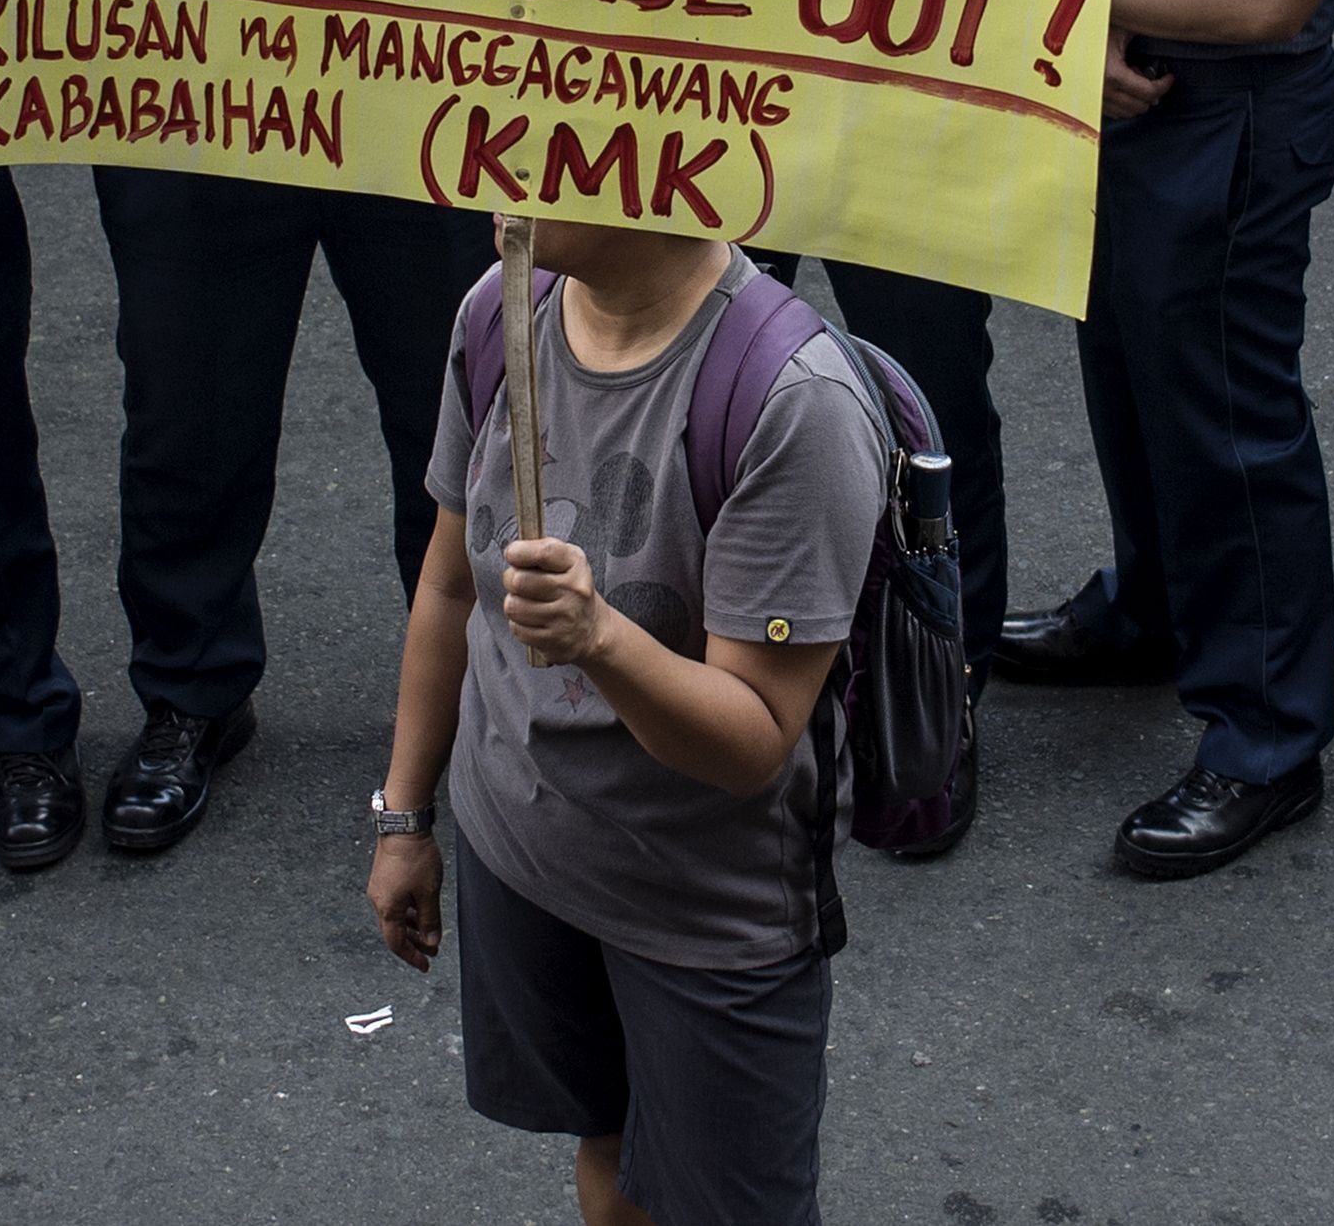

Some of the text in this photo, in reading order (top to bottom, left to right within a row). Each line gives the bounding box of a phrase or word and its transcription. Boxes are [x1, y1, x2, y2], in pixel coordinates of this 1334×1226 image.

[241, 15, 299, 77] ng
[321, 13, 795, 126] MANGGAGAWANG
[420, 94, 775, 243] (KMK)
